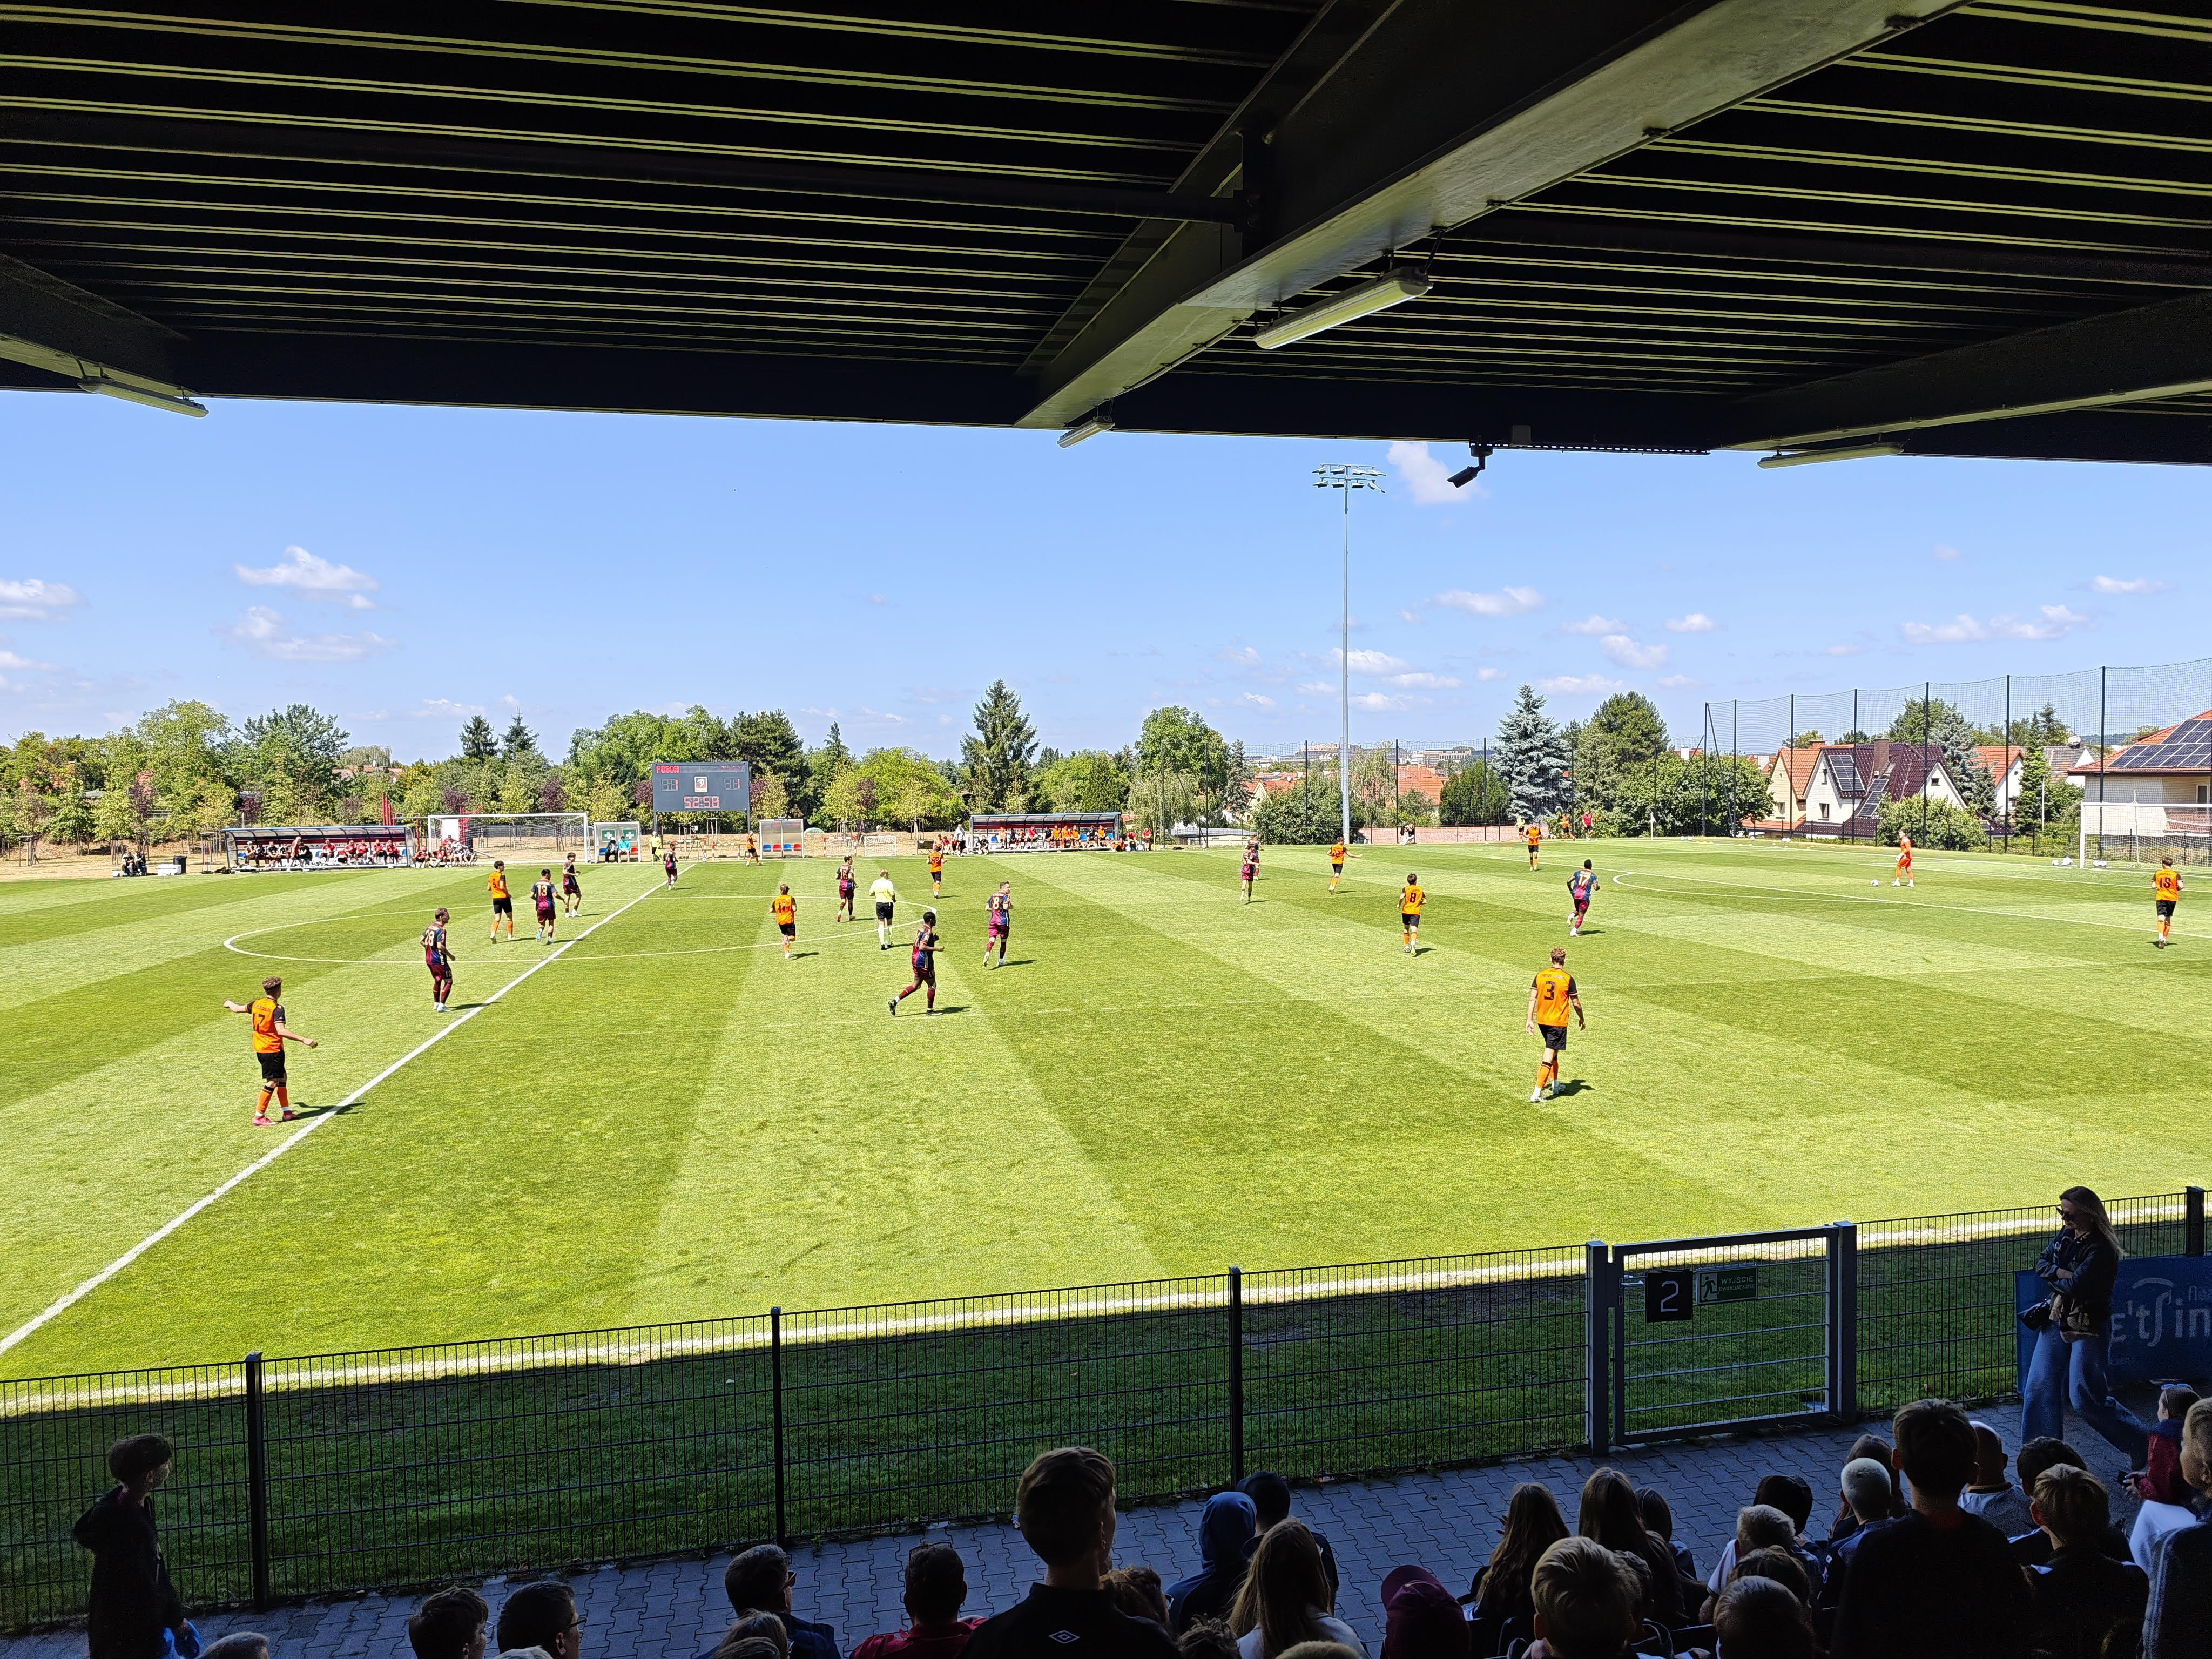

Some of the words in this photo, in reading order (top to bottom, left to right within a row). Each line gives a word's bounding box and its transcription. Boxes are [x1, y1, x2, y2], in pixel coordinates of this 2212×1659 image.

[683, 796, 720, 808] 52:58
[1578, 873, 1590, 886] 17
[537, 885, 547, 897] 13
[1410, 892, 1417, 903] 8
[993, 896, 1000, 910] 8
[1543, 981, 1555, 1000] 3
[1661, 1280, 1678, 1312] 2
